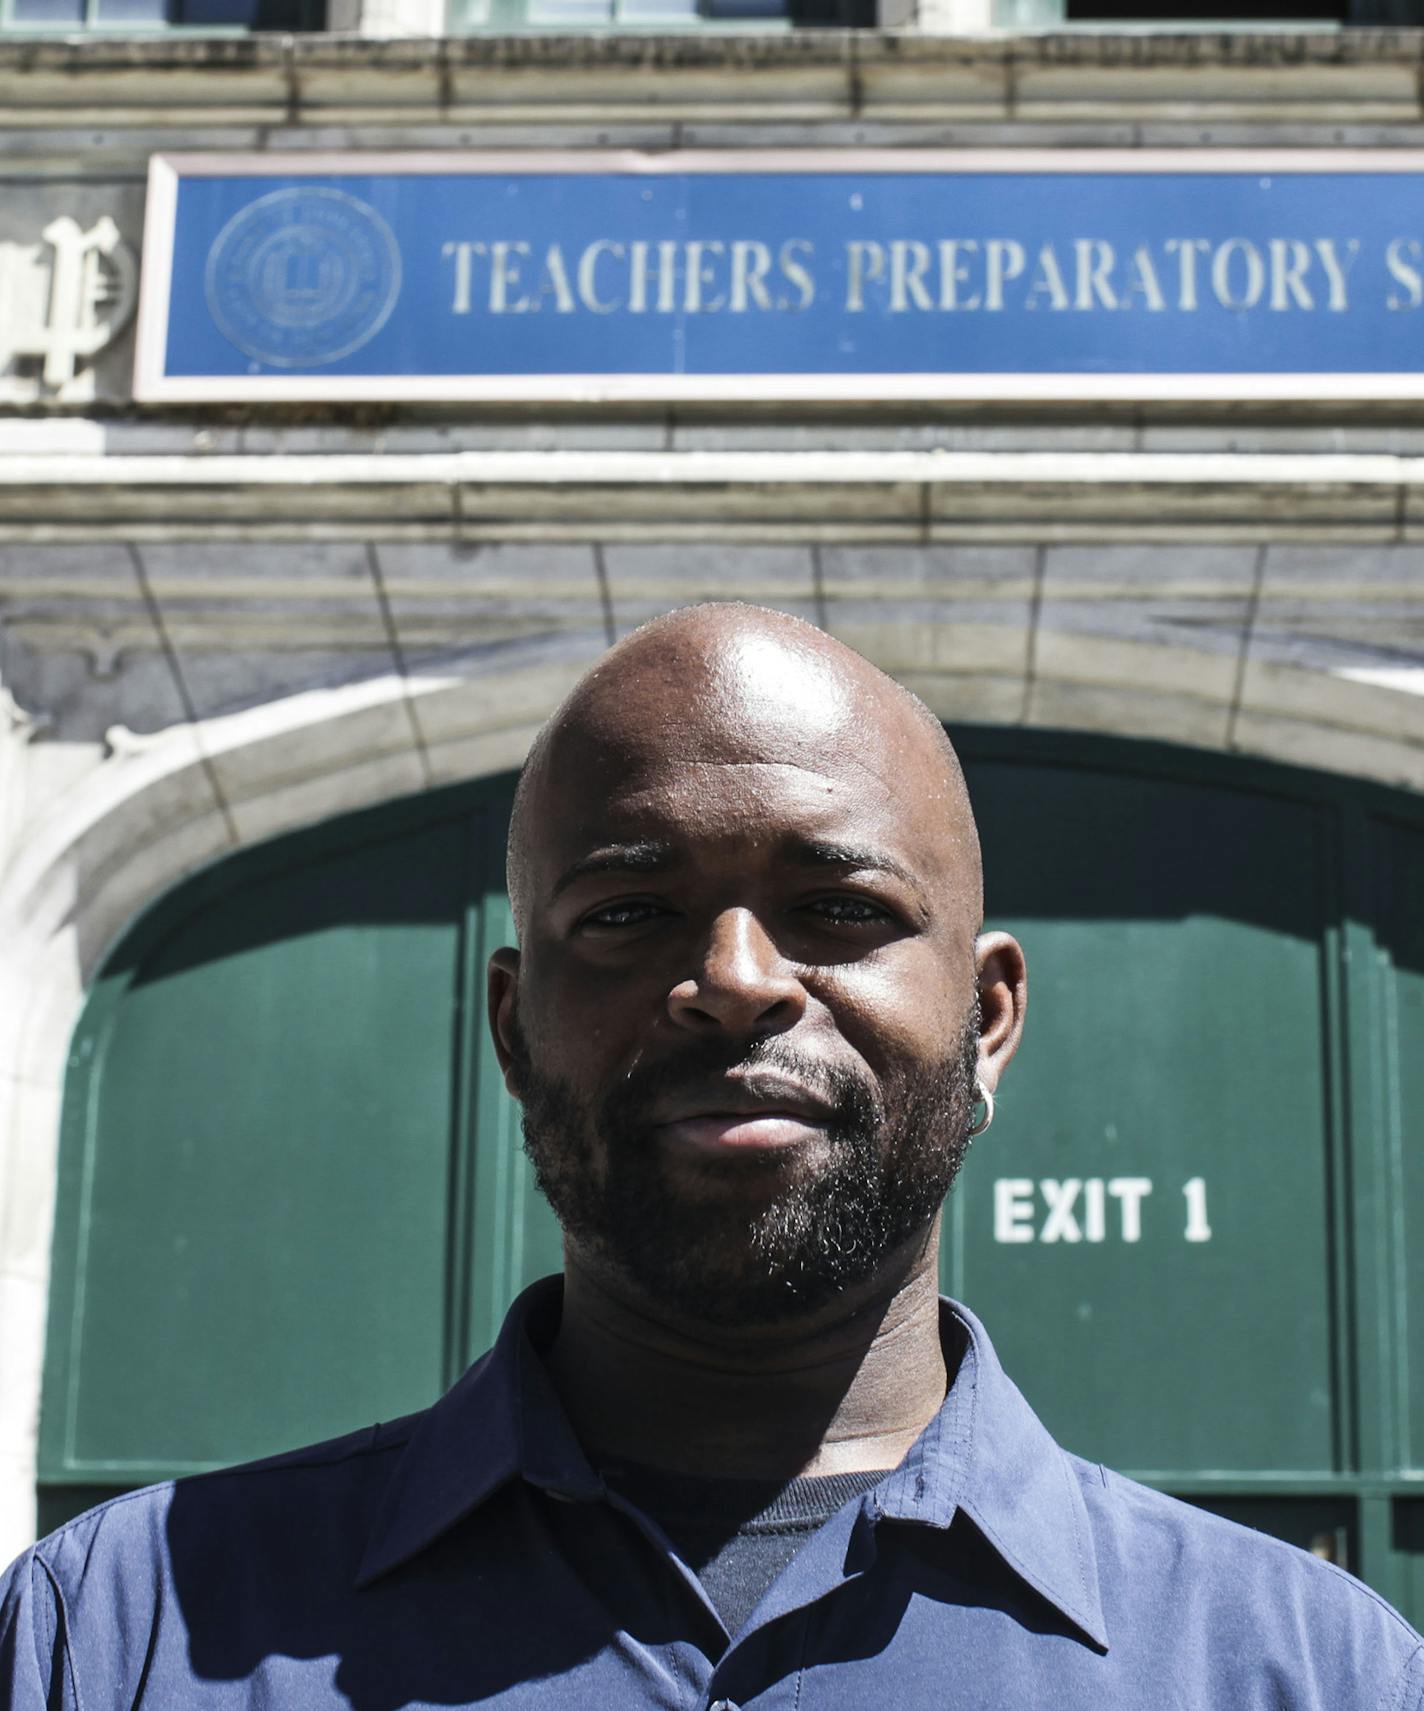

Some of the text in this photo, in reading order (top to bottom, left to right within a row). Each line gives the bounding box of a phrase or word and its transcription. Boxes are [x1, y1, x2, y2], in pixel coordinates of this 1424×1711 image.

[440, 238, 816, 314] TEACHERS
[845, 237, 1360, 313] PREPARATORY
[993, 1176, 1212, 1243] EXIT 1
